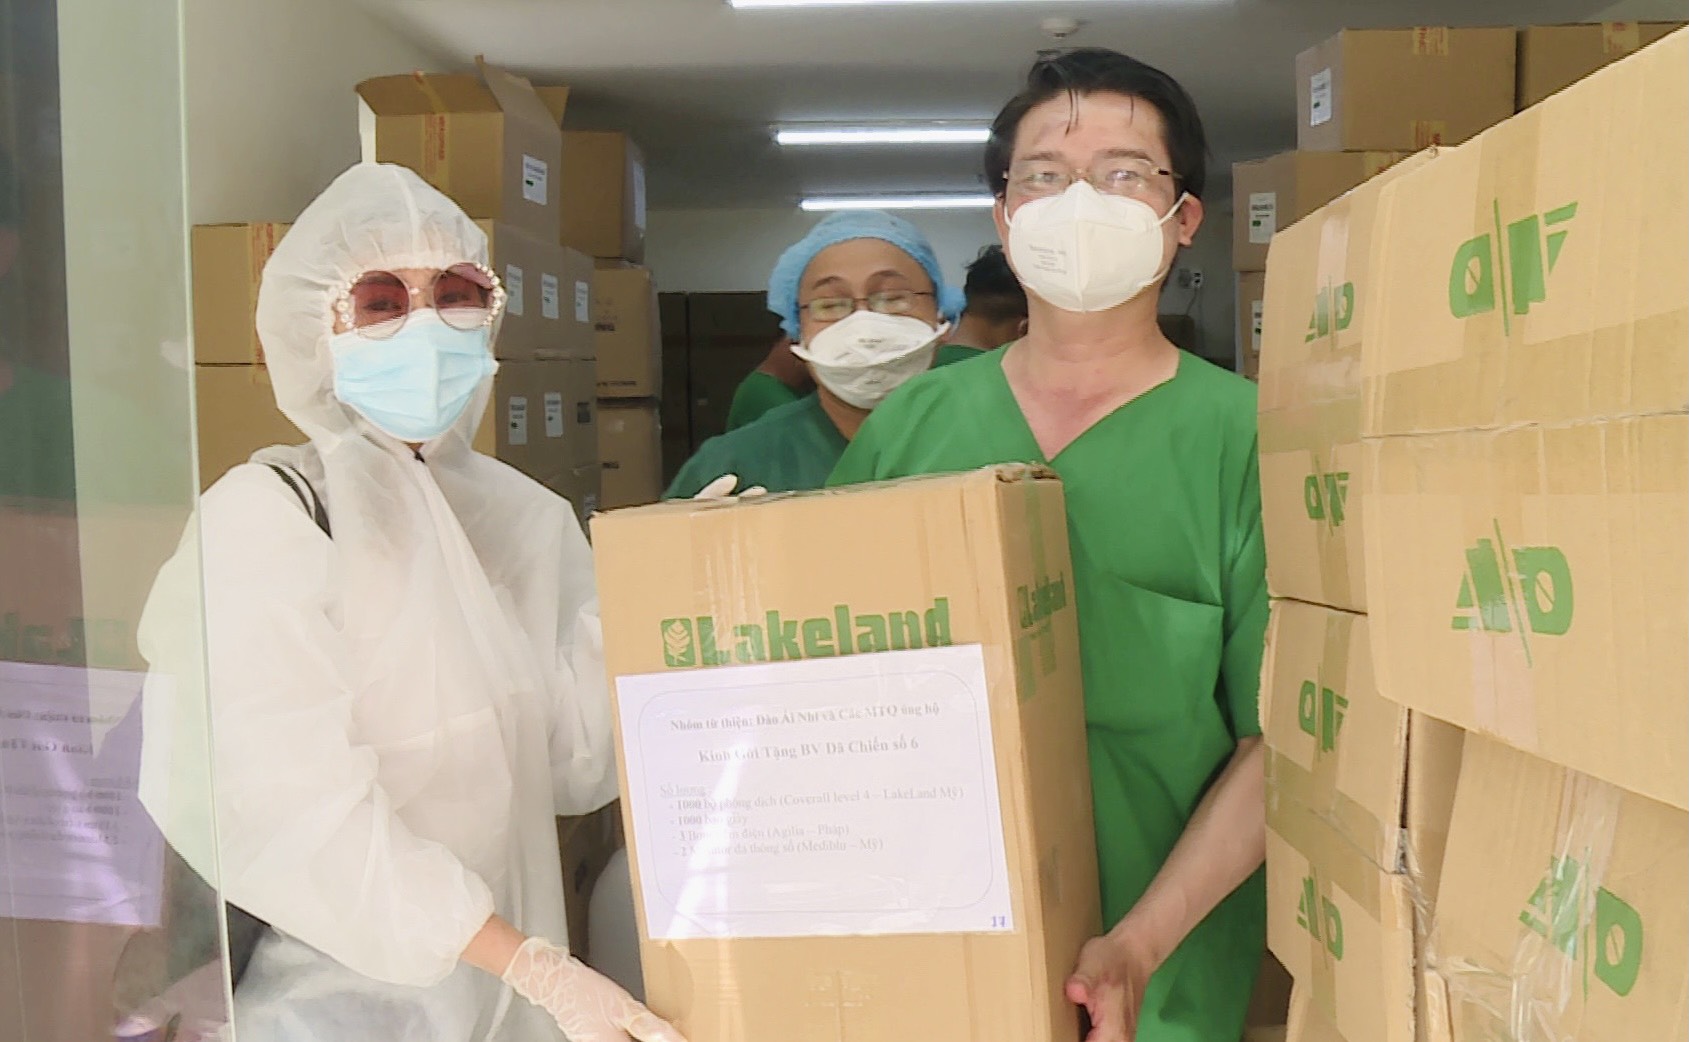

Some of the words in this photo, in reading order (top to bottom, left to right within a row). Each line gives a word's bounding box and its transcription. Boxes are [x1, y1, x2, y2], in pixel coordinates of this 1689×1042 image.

[697, 596, 952, 665] Lakeland
[801, 743, 820, 756] BV
[848, 735, 889, 754] Chiến
[893, 732, 908, 750] số
[911, 737, 920, 749] 6
